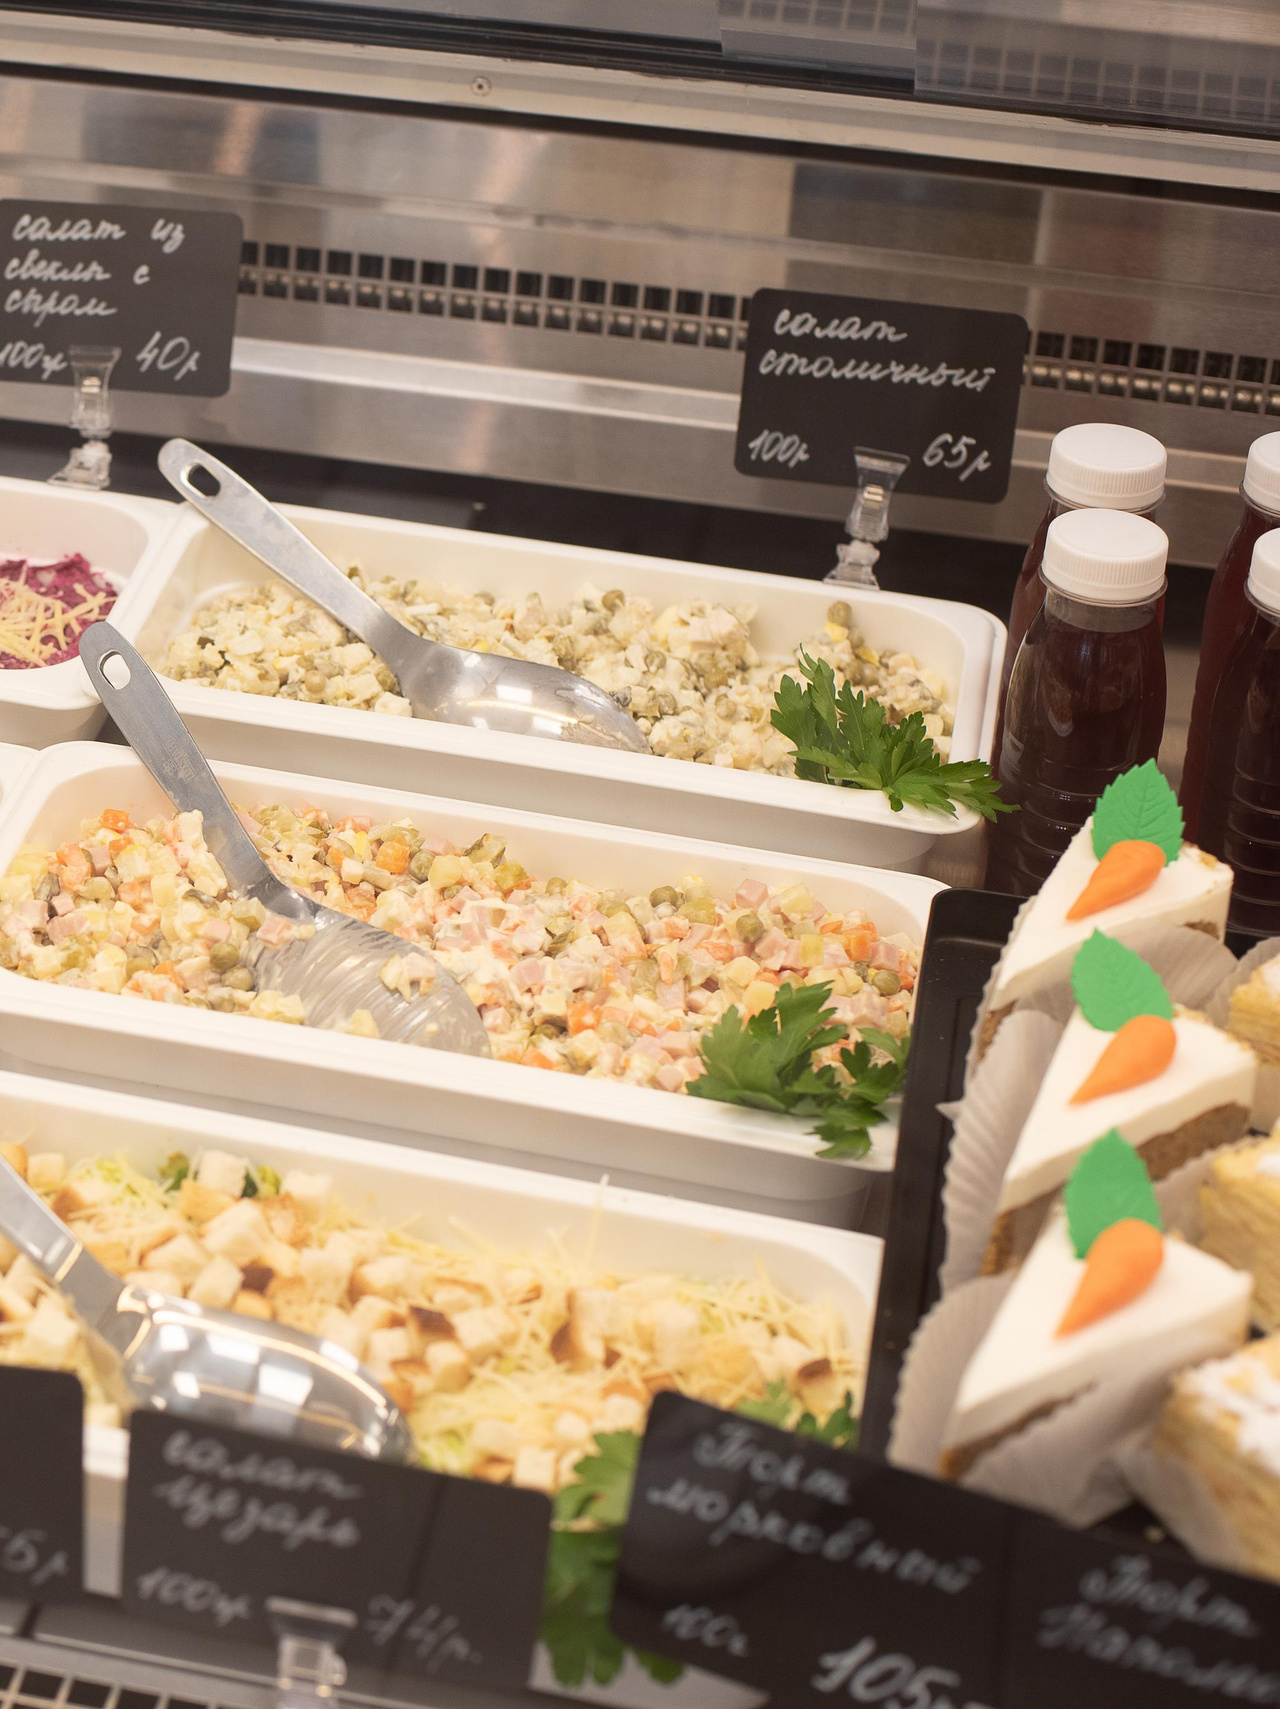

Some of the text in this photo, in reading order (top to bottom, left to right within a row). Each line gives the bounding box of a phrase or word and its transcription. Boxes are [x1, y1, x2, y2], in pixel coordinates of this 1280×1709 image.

[150, 217, 186, 254] из
[4, 248, 112, 282] свеклы
[691, 1420, 854, 1507] Торт
